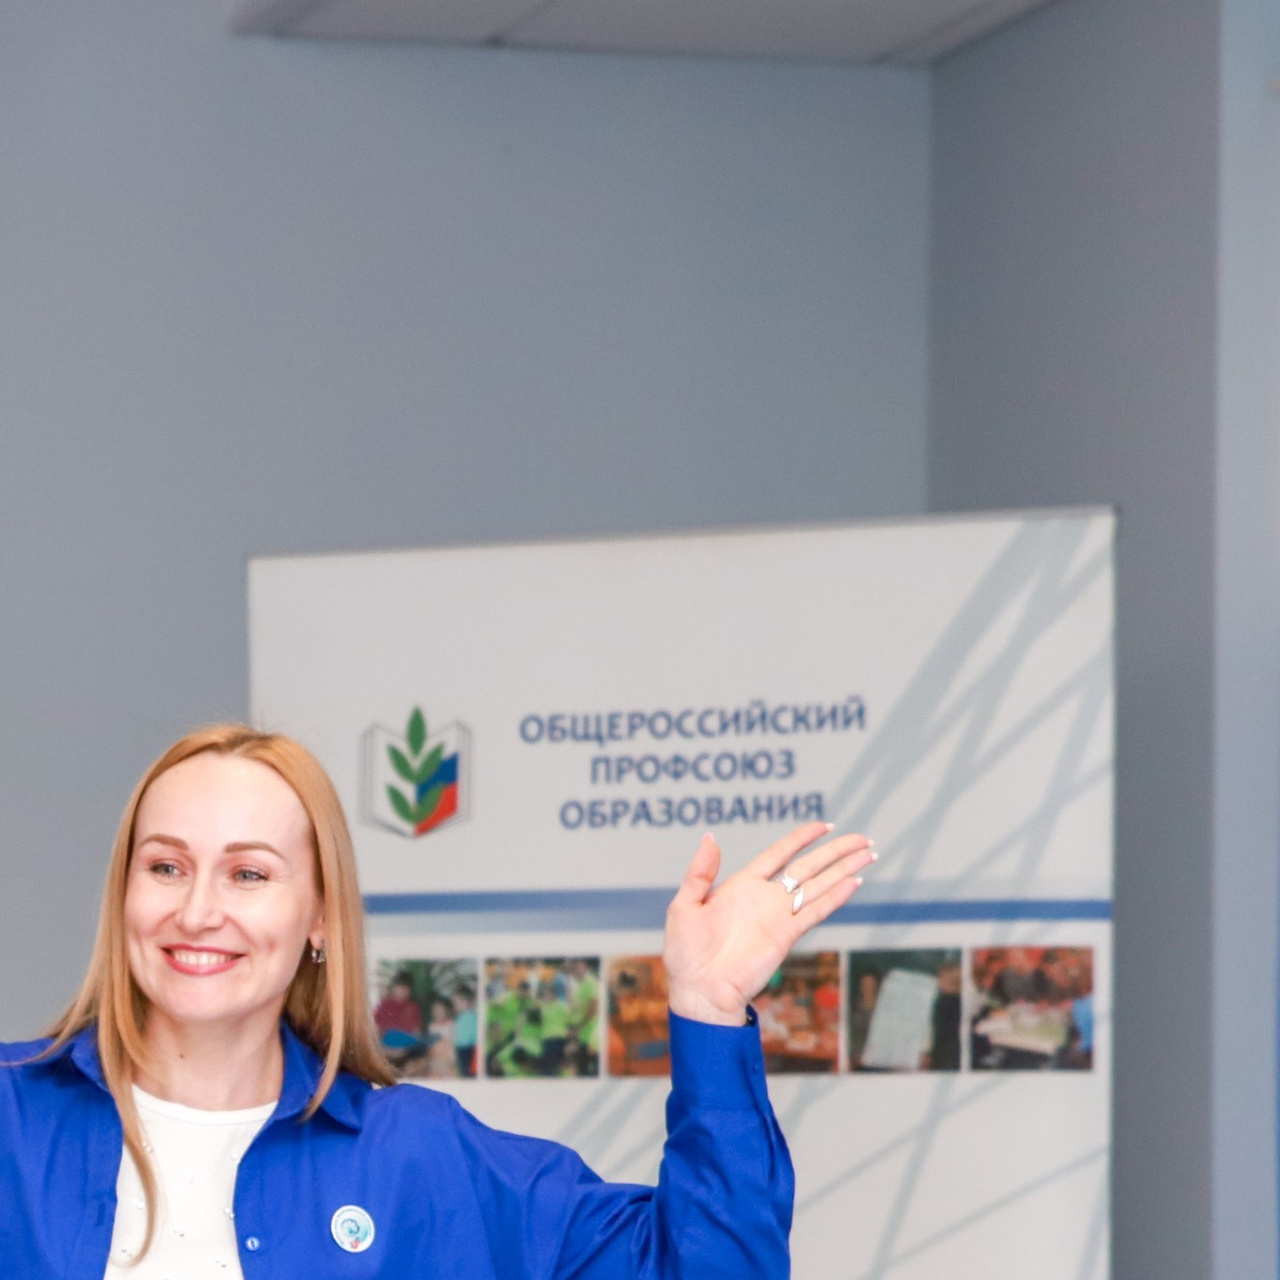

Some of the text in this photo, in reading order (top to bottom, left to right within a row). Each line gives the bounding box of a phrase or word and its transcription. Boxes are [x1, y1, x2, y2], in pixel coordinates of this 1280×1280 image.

[519, 695, 867, 747] ОБЩЕРОССИЙСКИЙ
[590, 749, 797, 785] ПРОФСОЮЗ
[558, 793, 826, 830] ОБРАЗОВАНИЯ
